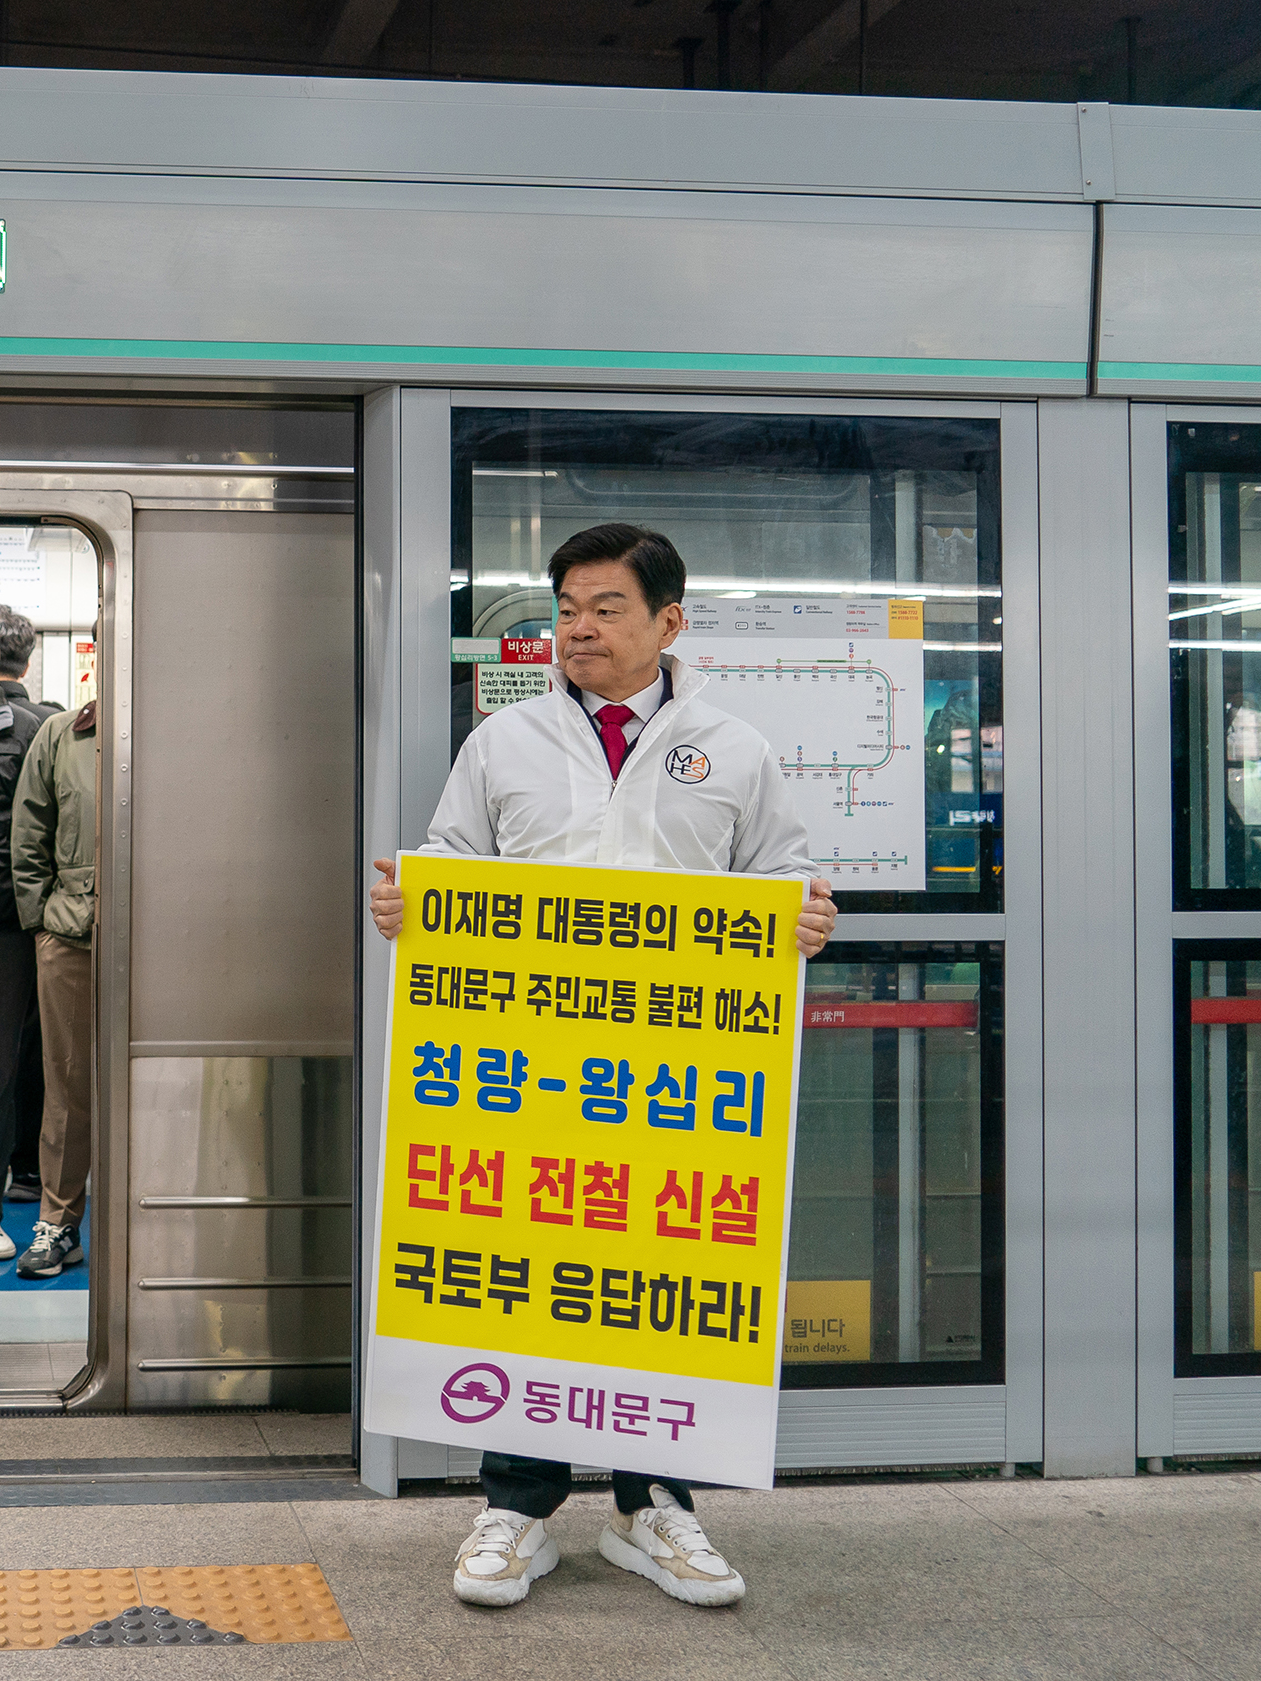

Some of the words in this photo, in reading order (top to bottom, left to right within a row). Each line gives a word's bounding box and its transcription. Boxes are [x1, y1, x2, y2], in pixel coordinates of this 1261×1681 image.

[508, 641, 544, 654] 비상문
[422, 888, 523, 940] 이재명
[536, 896, 678, 951] 대통령의
[693, 907, 777, 958] 약속!
[409, 964, 516, 1013] 동대문구
[526, 974, 637, 1024] 주민교통
[648, 983, 703, 1030] 불편
[714, 987, 781, 1035] 해소!
[811, 1011, 845, 1022] 非常門
[413, 1040, 765, 1137] 청량-왕십리
[407, 1143, 505, 1218] 단선
[529, 1155, 630, 1232] 전철
[655, 1169, 759, 1246] 신설
[394, 1242, 530, 1315] 국토부
[550, 1261, 761, 1344] 응답하라!
[784, 1343, 809, 1353] train
[813, 1342, 850, 1355] delays.
[791, 1318, 845, 1338] 됩니다
[523, 1380, 696, 1441] 동대문구
